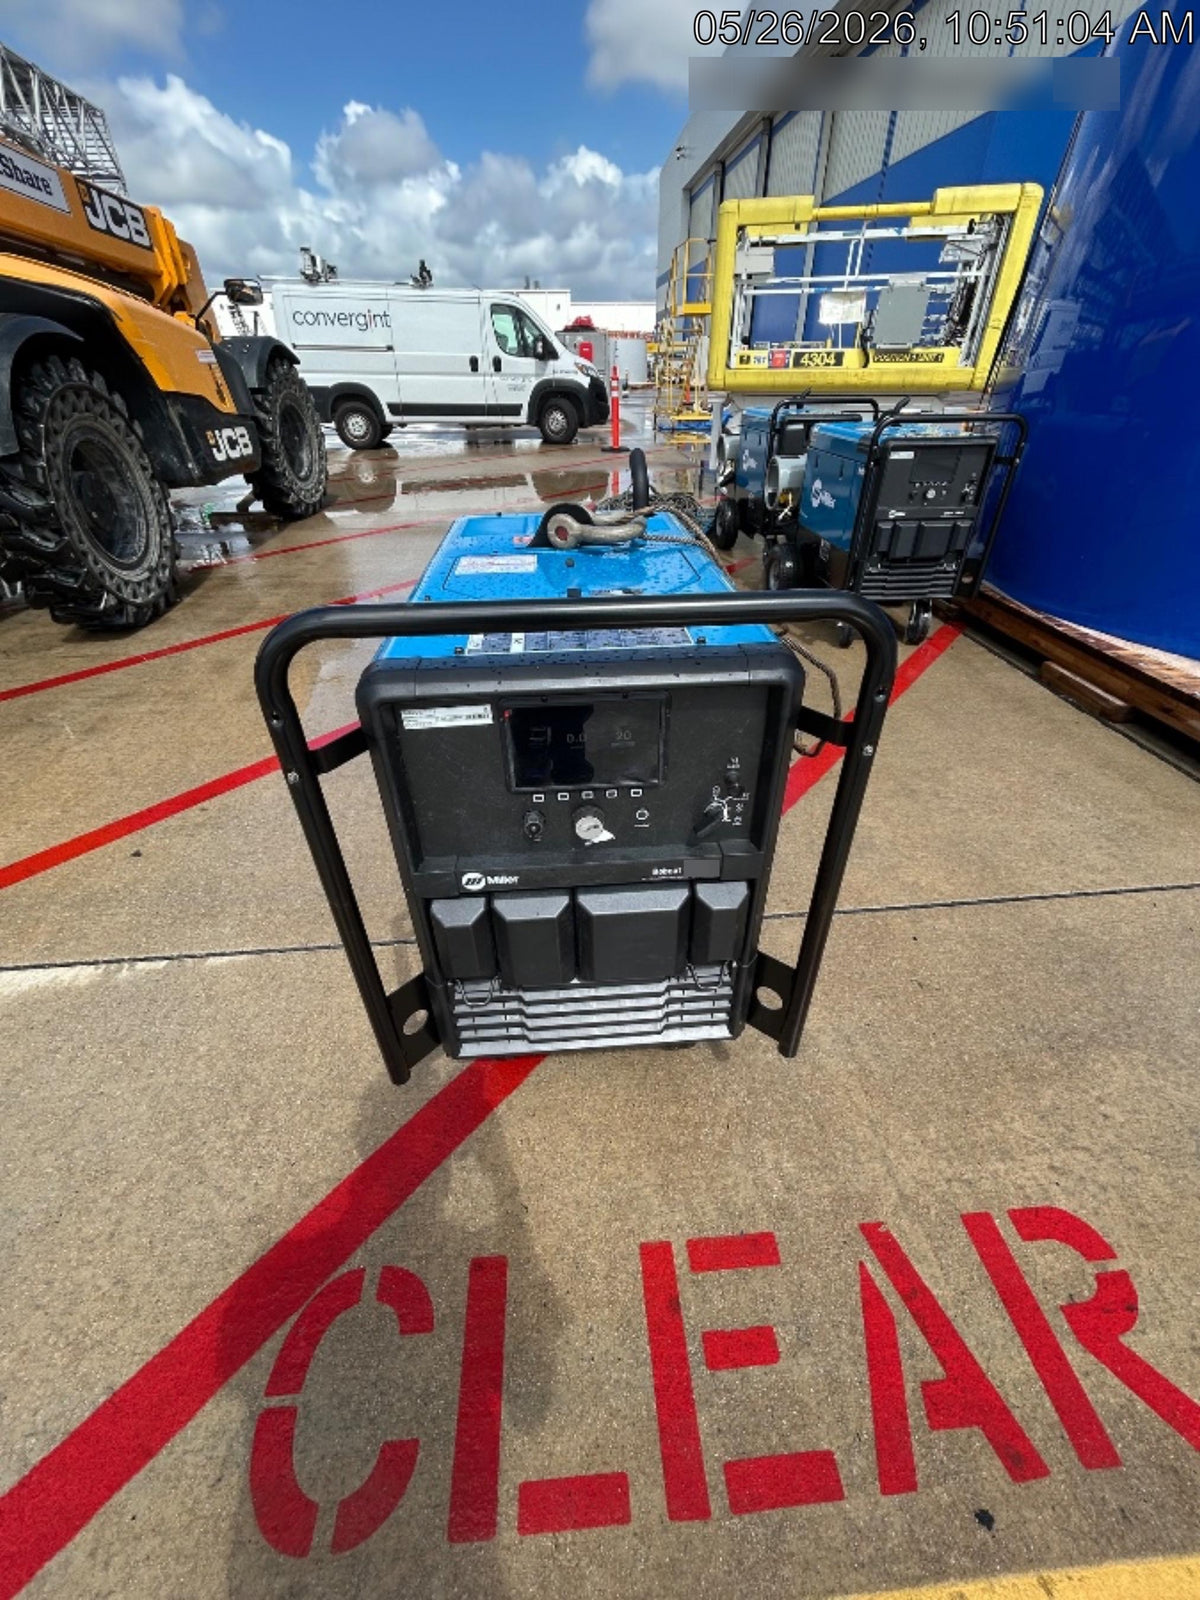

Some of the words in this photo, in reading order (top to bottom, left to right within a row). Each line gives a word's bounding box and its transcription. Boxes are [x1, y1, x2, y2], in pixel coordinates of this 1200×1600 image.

[0, 153, 53, 196] Share
[84, 187, 152, 248] JCB
[292, 309, 392, 332] convergint
[800, 353, 836, 367] 4304
[211, 426, 254, 461] JCB
[249, 1205, 1200, 1557] CLEAR
